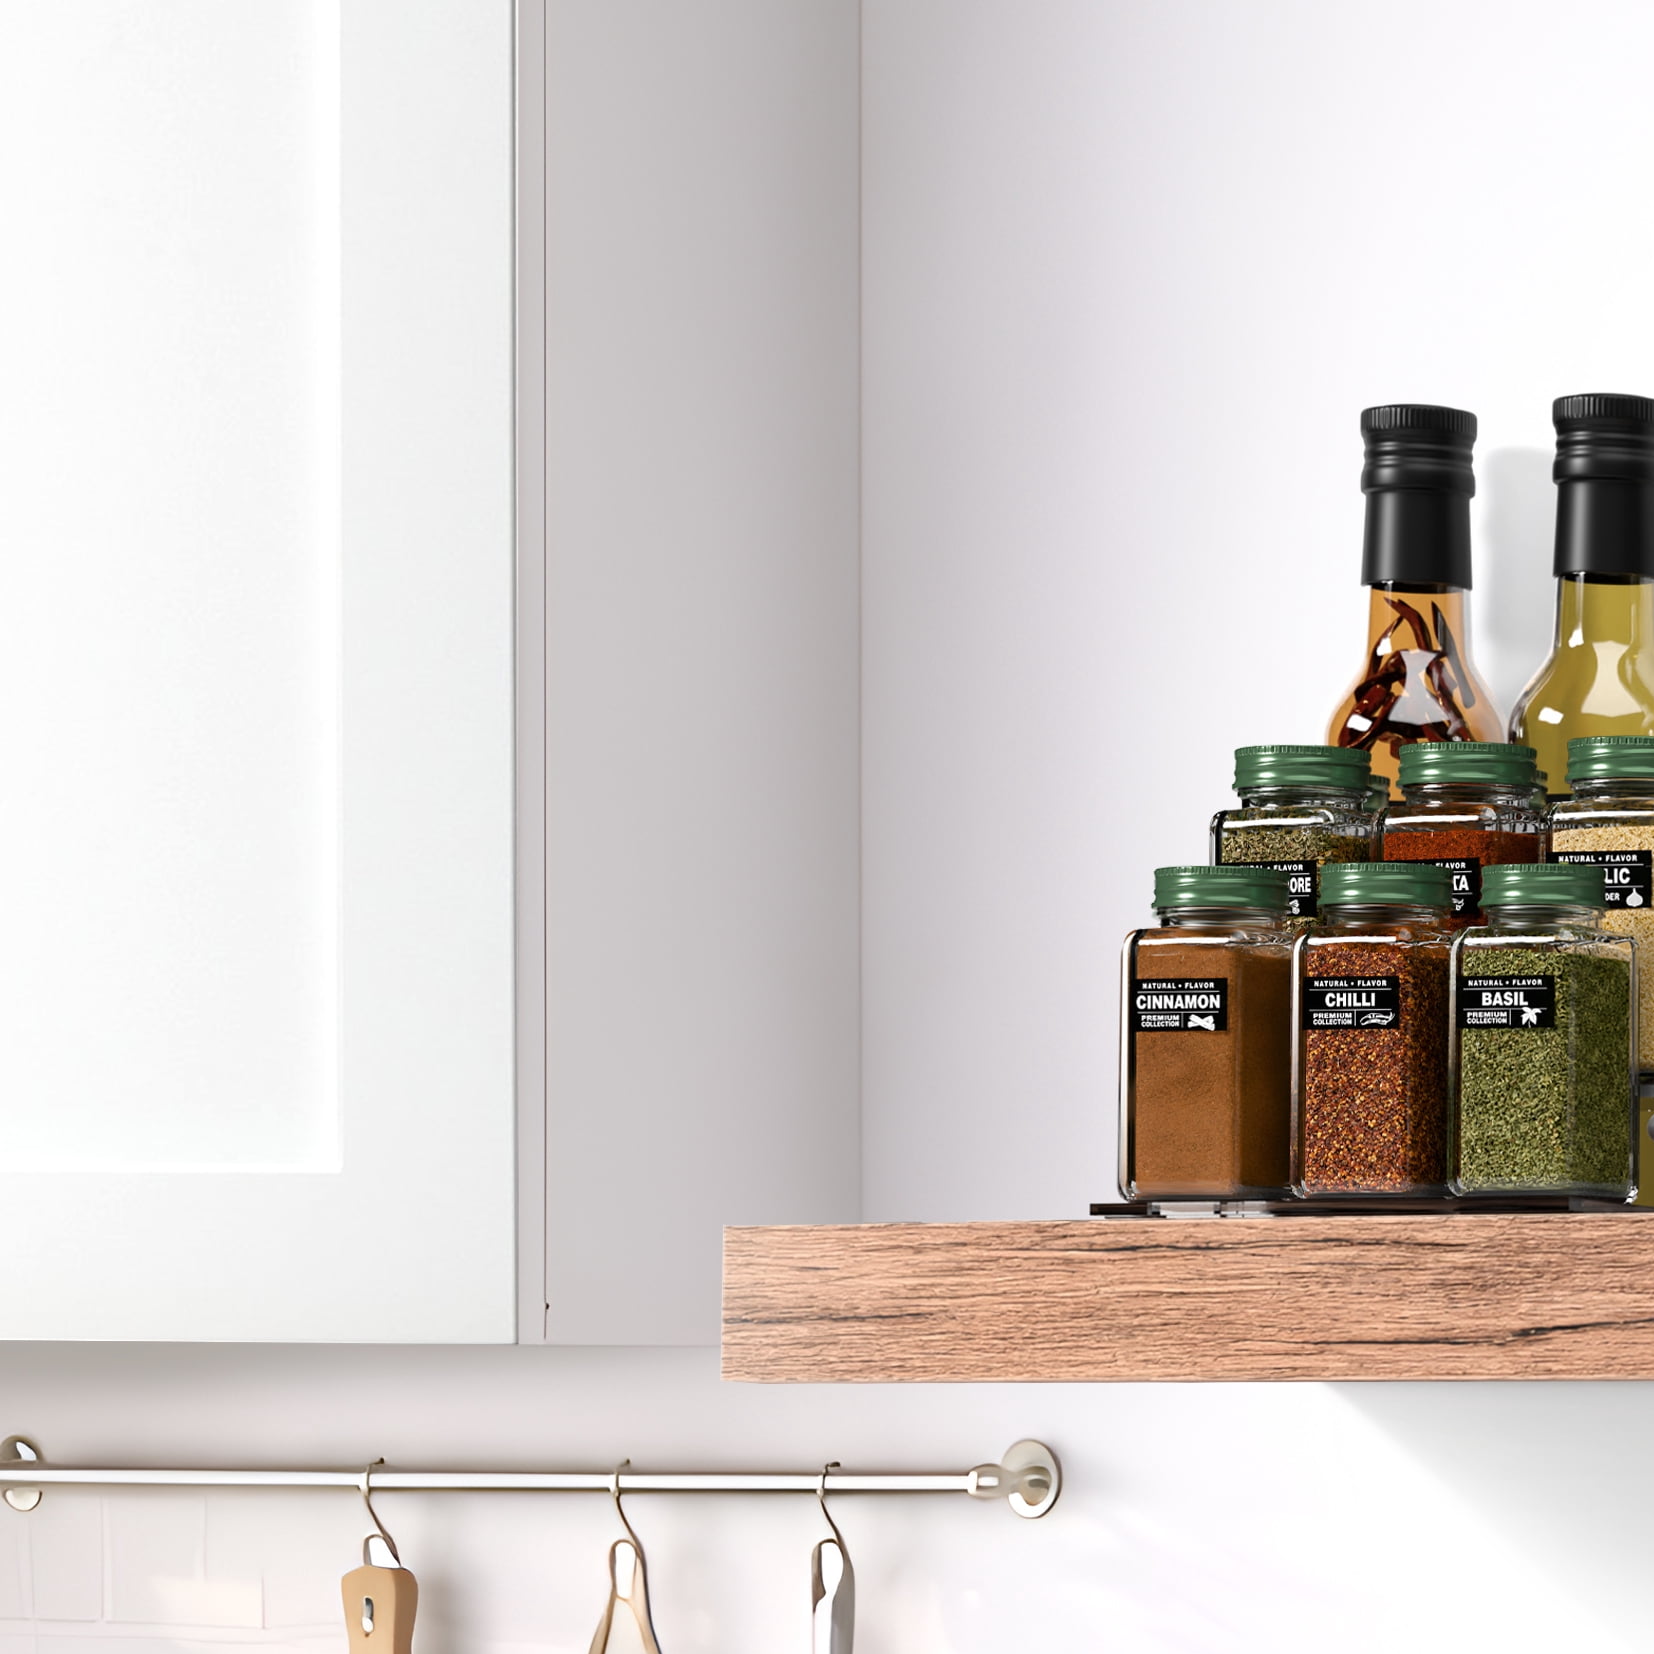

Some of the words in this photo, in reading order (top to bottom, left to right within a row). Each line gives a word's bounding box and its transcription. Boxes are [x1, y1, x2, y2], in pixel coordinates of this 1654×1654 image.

[1558, 855, 1596, 863] NATURAL
[1605, 854, 1638, 862] FLAVOR
[1273, 864, 1304, 872] FLAVOR
[1287, 876, 1312, 894] ORE
[1313, 980, 1349, 988] NATURAL
[1357, 979, 1387, 987] FLAVOR
[1468, 979, 1503, 987] NATURAL
[1136, 994, 1221, 1010] CINNAMON
[1324, 992, 1376, 1008] CHILLI
[1481, 991, 1529, 1007] BASIL
[1140, 1020, 1180, 1028] COLLECTION
[1312, 1018, 1353, 1026] COLLECTION
[1466, 1017, 1508, 1025] COLLECTION
